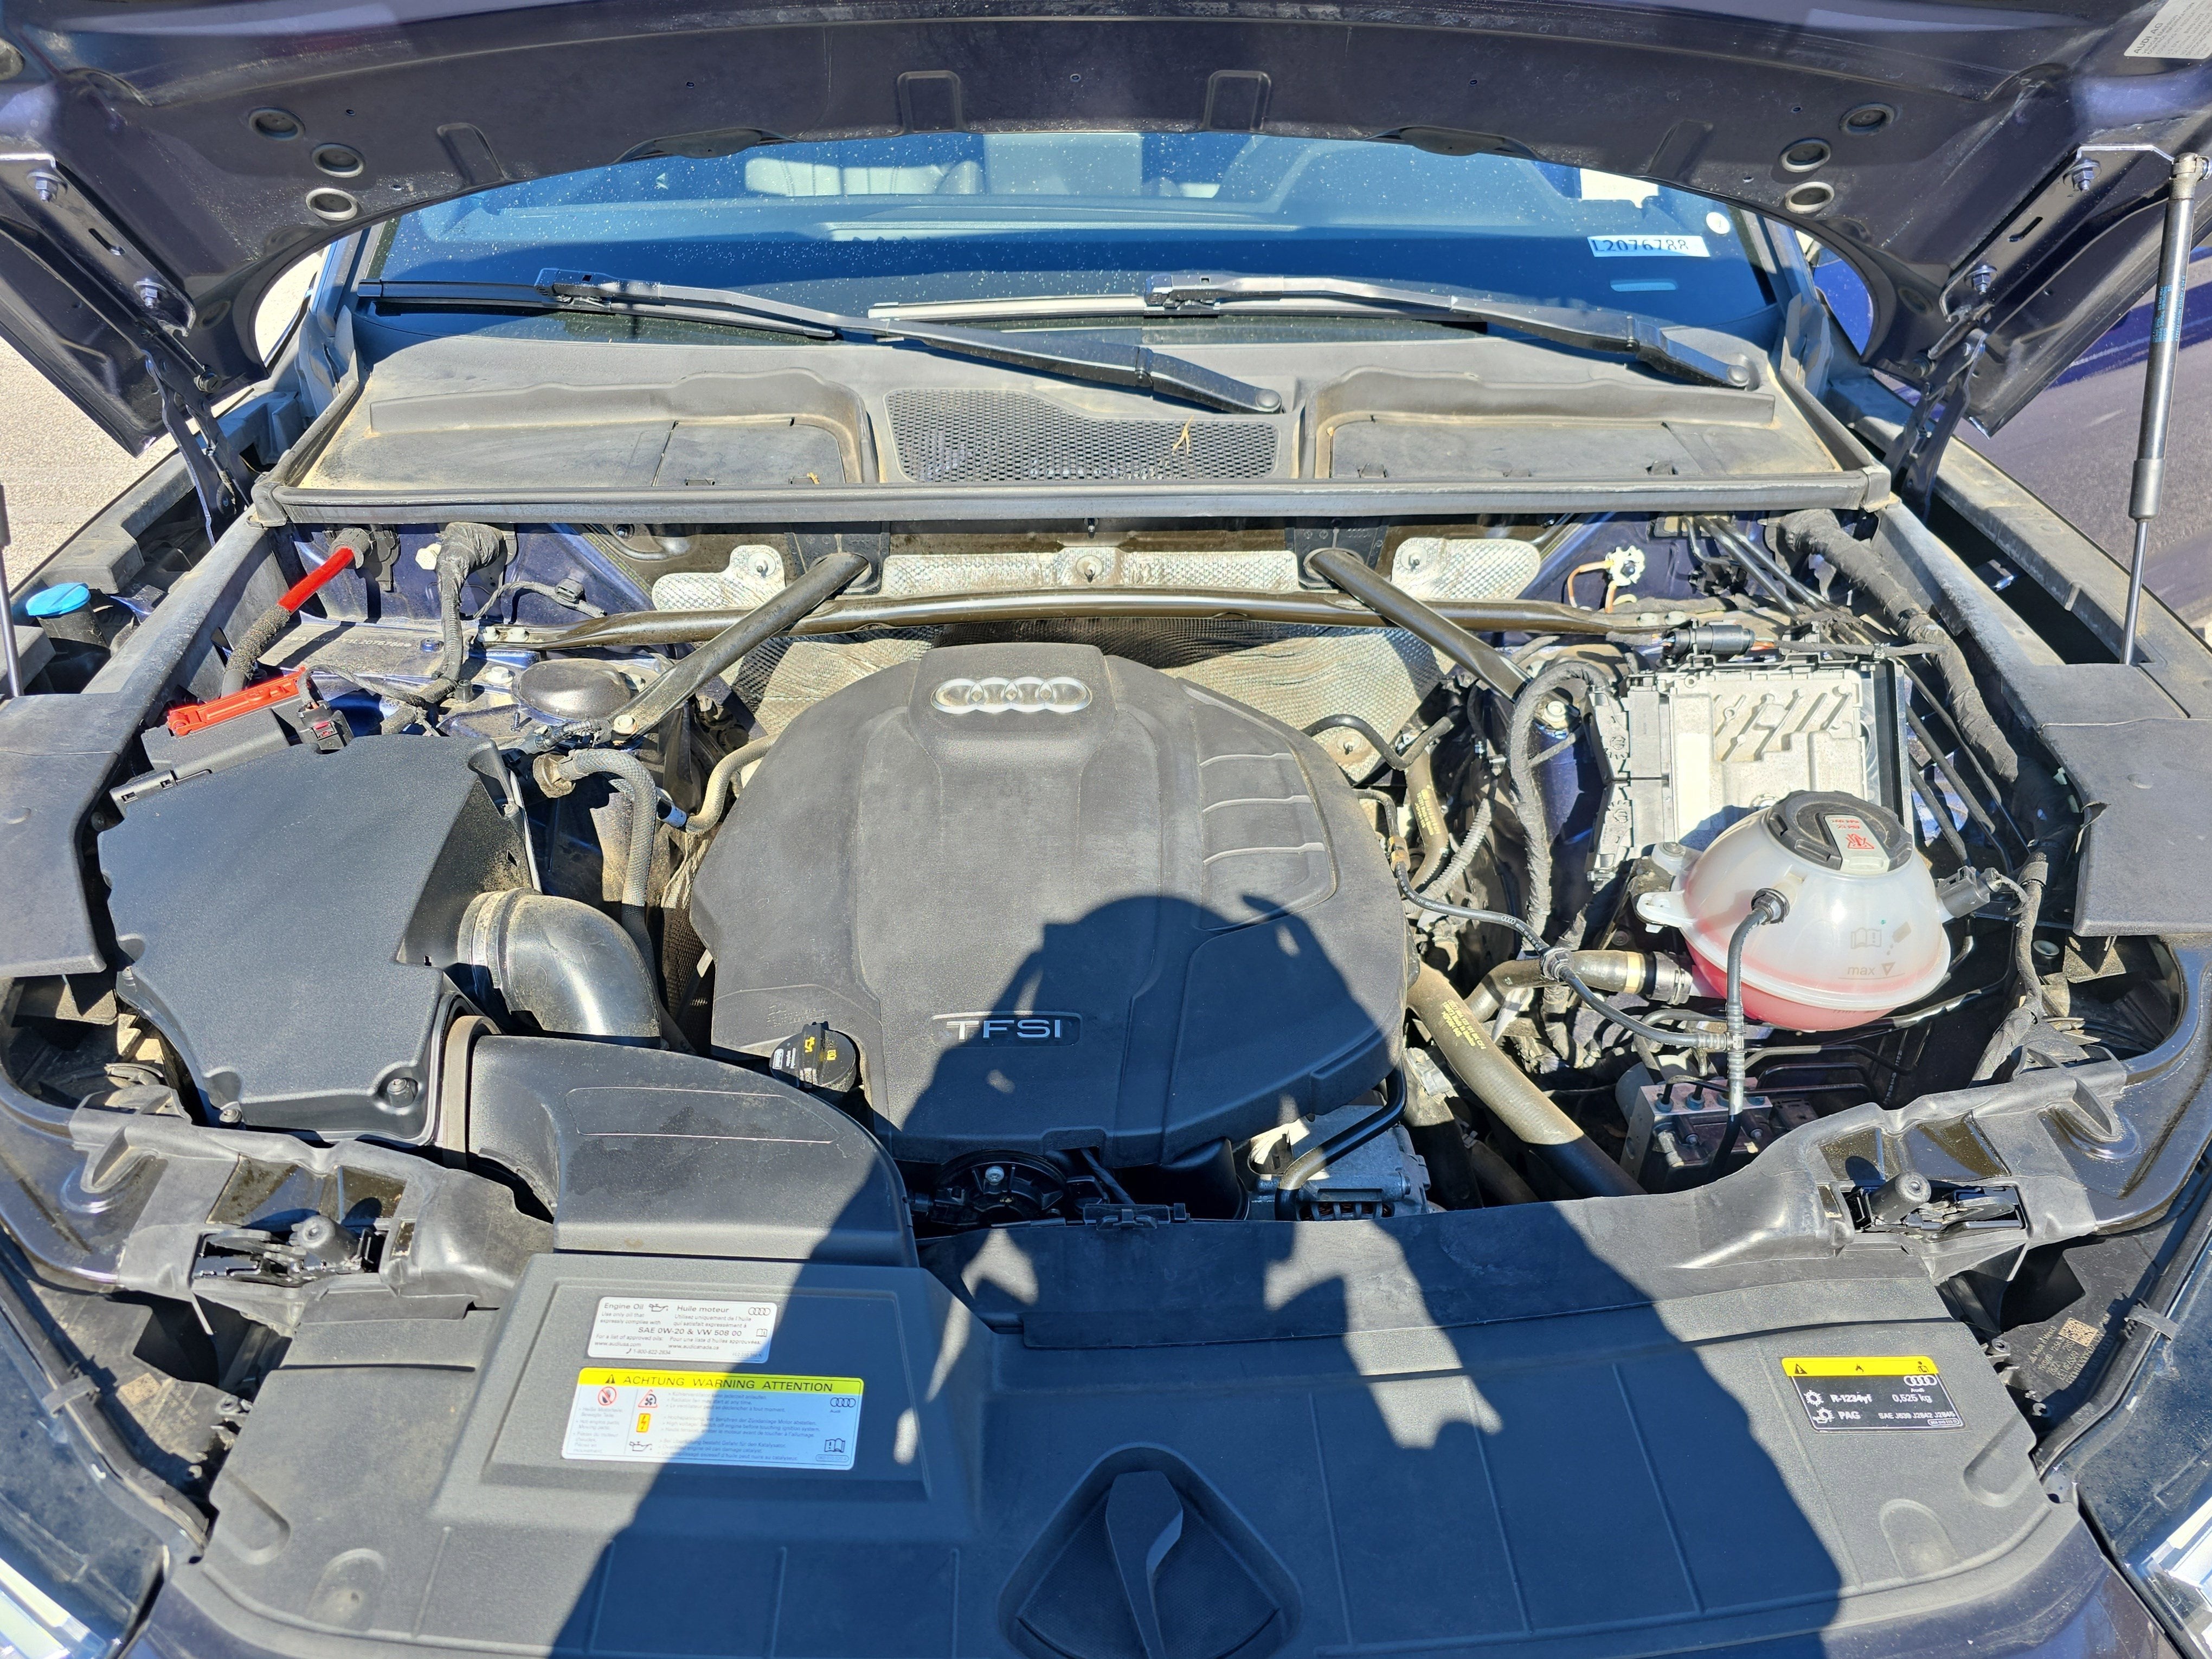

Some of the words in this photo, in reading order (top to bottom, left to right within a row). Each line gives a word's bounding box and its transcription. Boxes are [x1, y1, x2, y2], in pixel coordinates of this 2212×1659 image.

[2133, 36, 2152, 54] AUDI
[2152, 23, 2164, 34] AG
[1592, 240, 1688, 251] L2076788
[1847, 966, 1875, 975] max
[947, 1020, 1060, 1041] TFSI
[1463, 1030, 1475, 1046] Mexico
[2045, 1326, 2057, 1340] Mexico
[623, 1376, 684, 1386] ACHTUNG
[693, 1378, 755, 1388] WARNING
[762, 1381, 833, 1392] ATTENTION
[1829, 1394, 1873, 1404] R-1234yf
[1892, 1394, 1918, 1403] 0,525
[1919, 1394, 1932, 1403] kg
[1837, 1411, 1861, 1420] PAG
